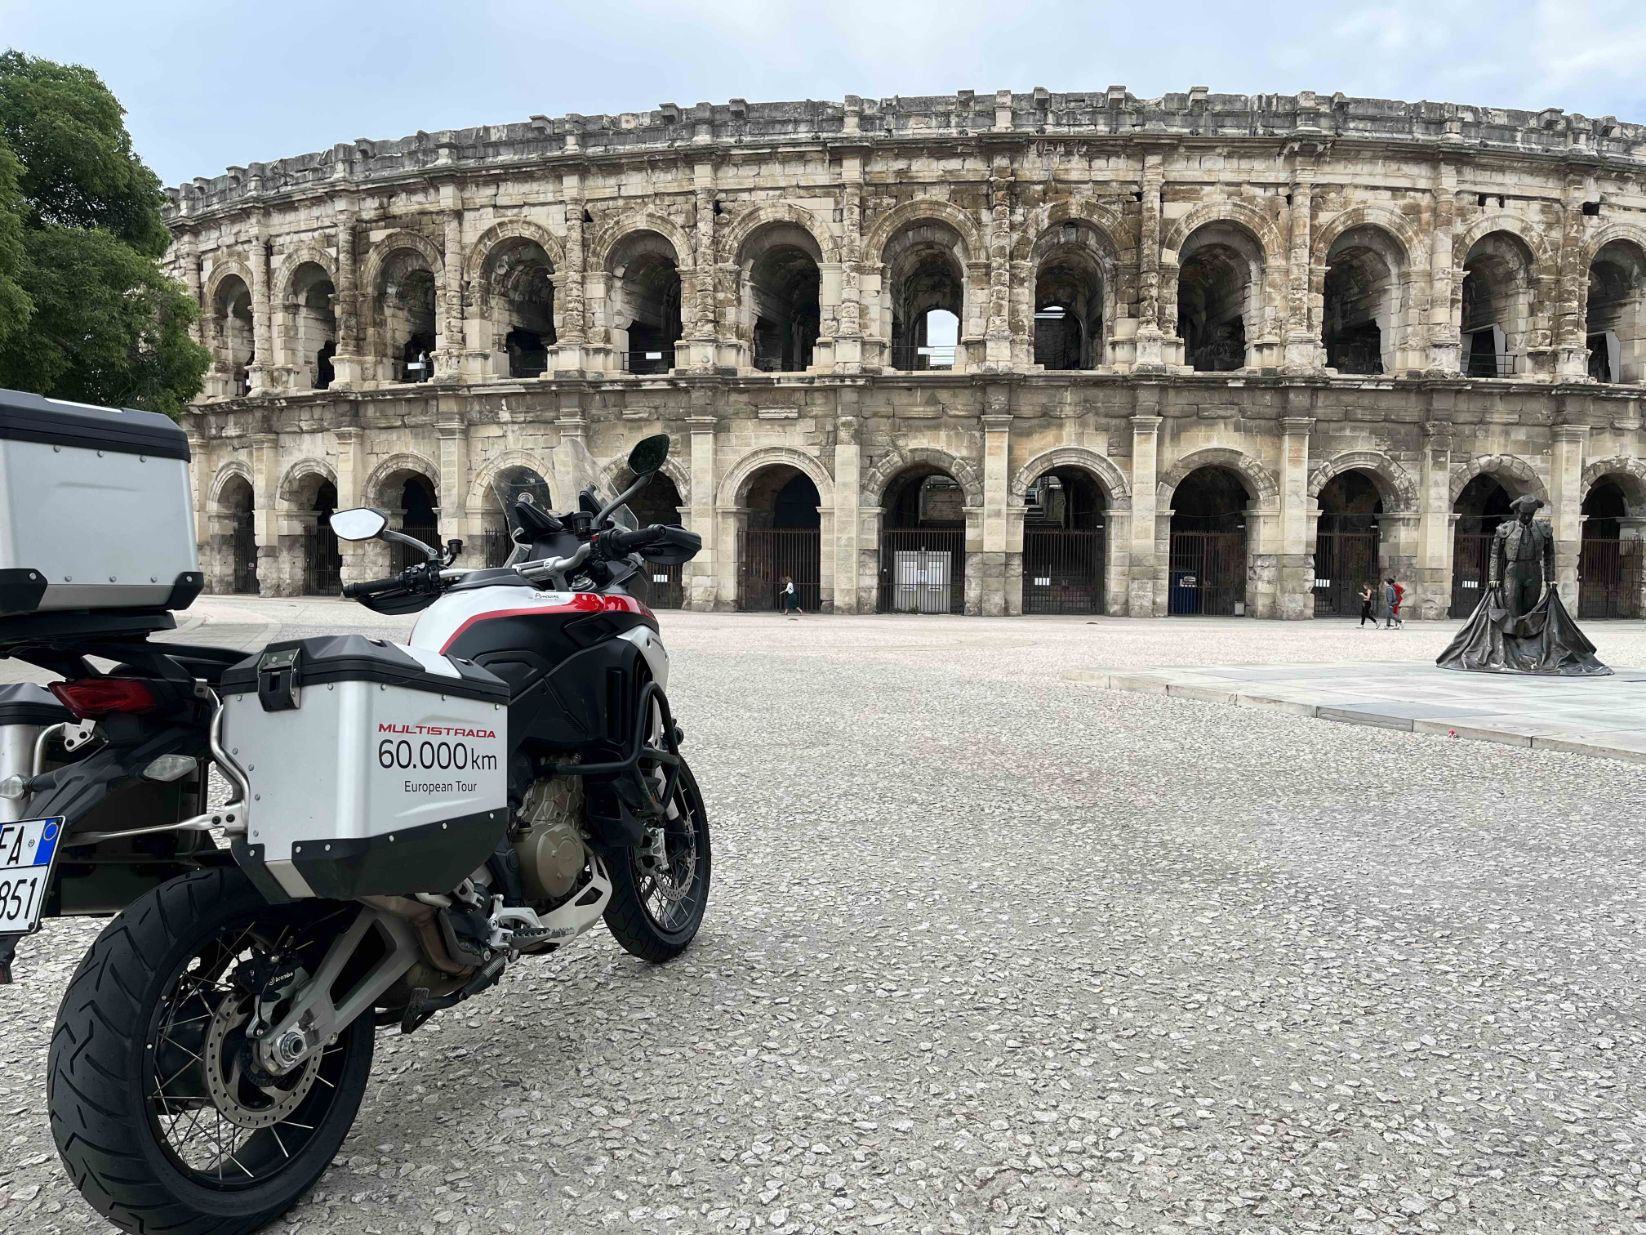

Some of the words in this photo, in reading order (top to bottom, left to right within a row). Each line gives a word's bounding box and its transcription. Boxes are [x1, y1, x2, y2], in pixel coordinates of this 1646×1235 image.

[378, 723, 496, 738] MULTISTRADA
[378, 739, 468, 770] 60.000
[471, 747, 497, 770] km
[404, 780, 453, 795] European
[455, 780, 477, 792] Tour
